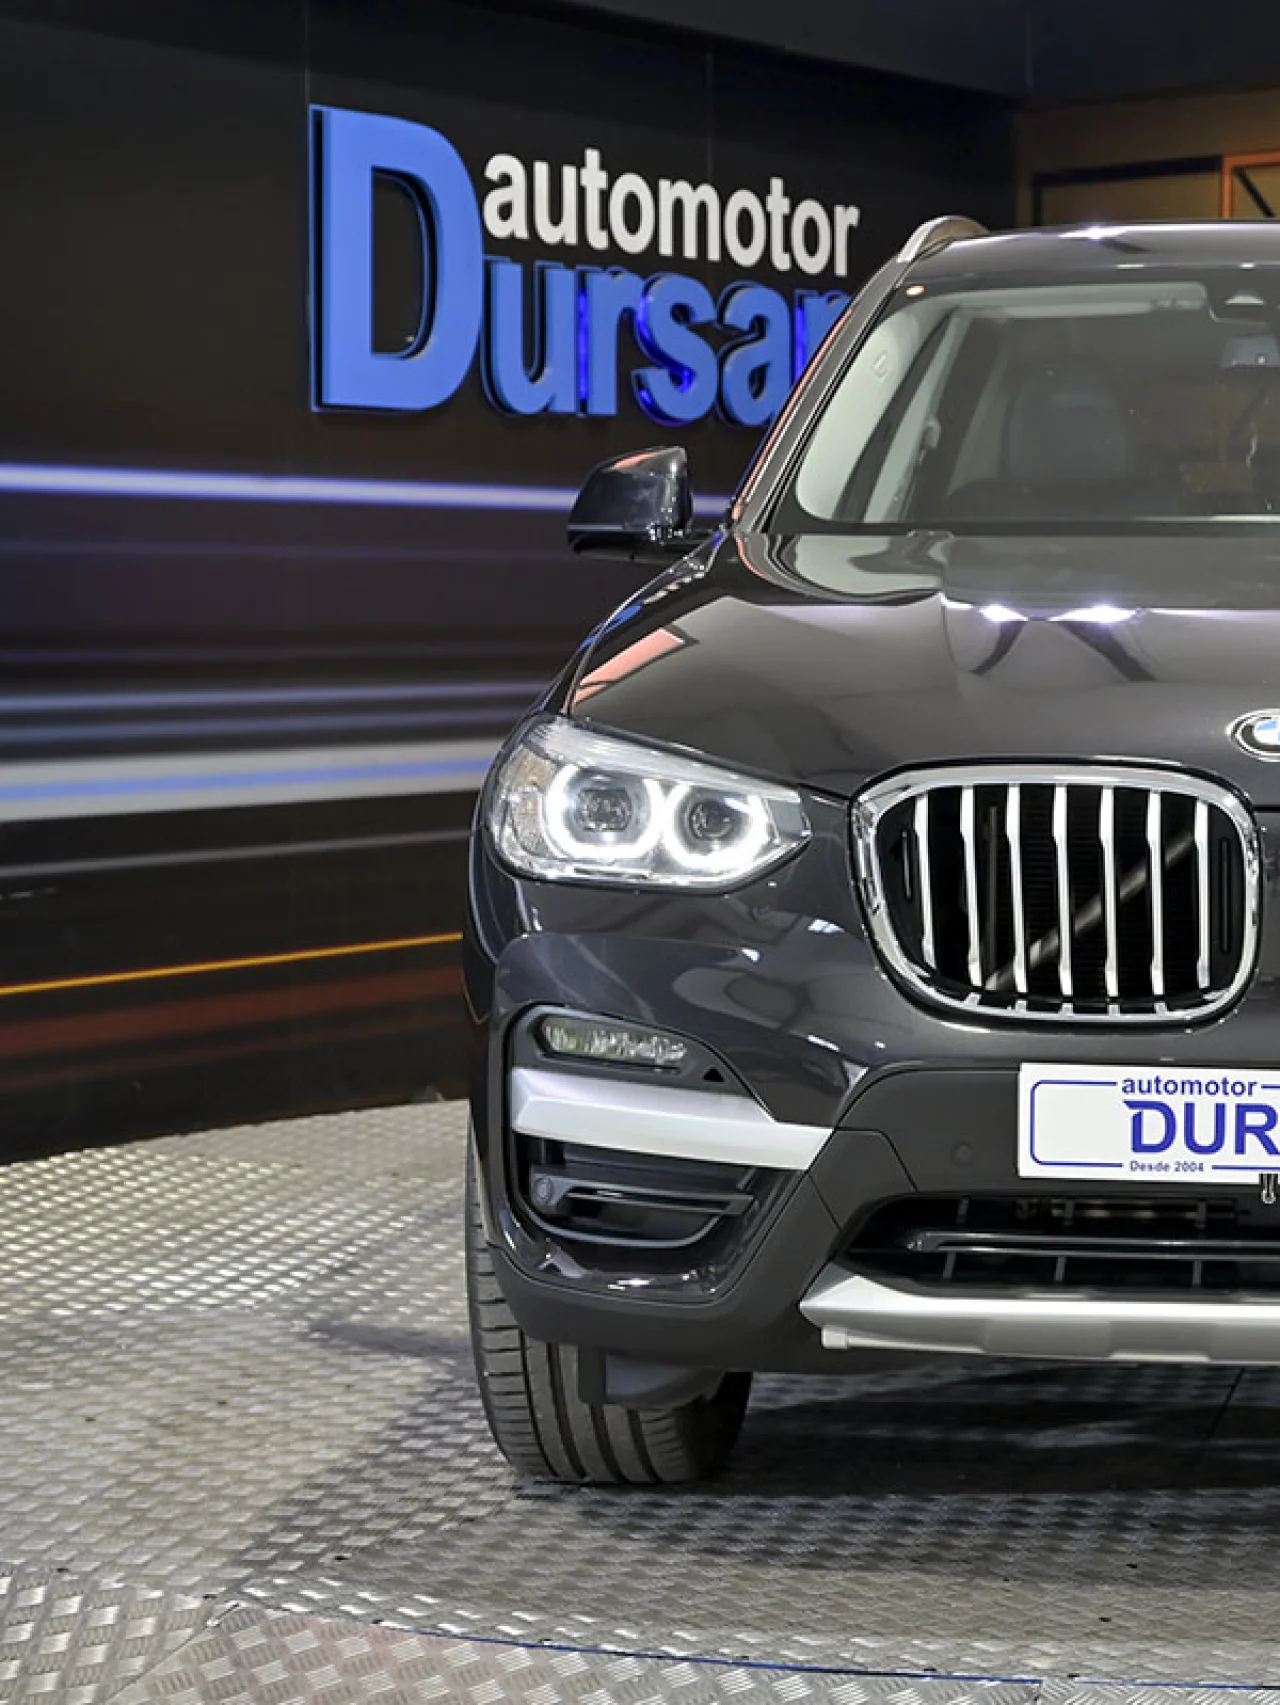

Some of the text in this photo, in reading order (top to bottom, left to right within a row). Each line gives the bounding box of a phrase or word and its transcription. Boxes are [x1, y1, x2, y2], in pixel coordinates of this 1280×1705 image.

[483, 148, 860, 276] automotor
[1121, 1075, 1257, 1096] automotor
[1130, 1160, 1170, 1172] Desde
